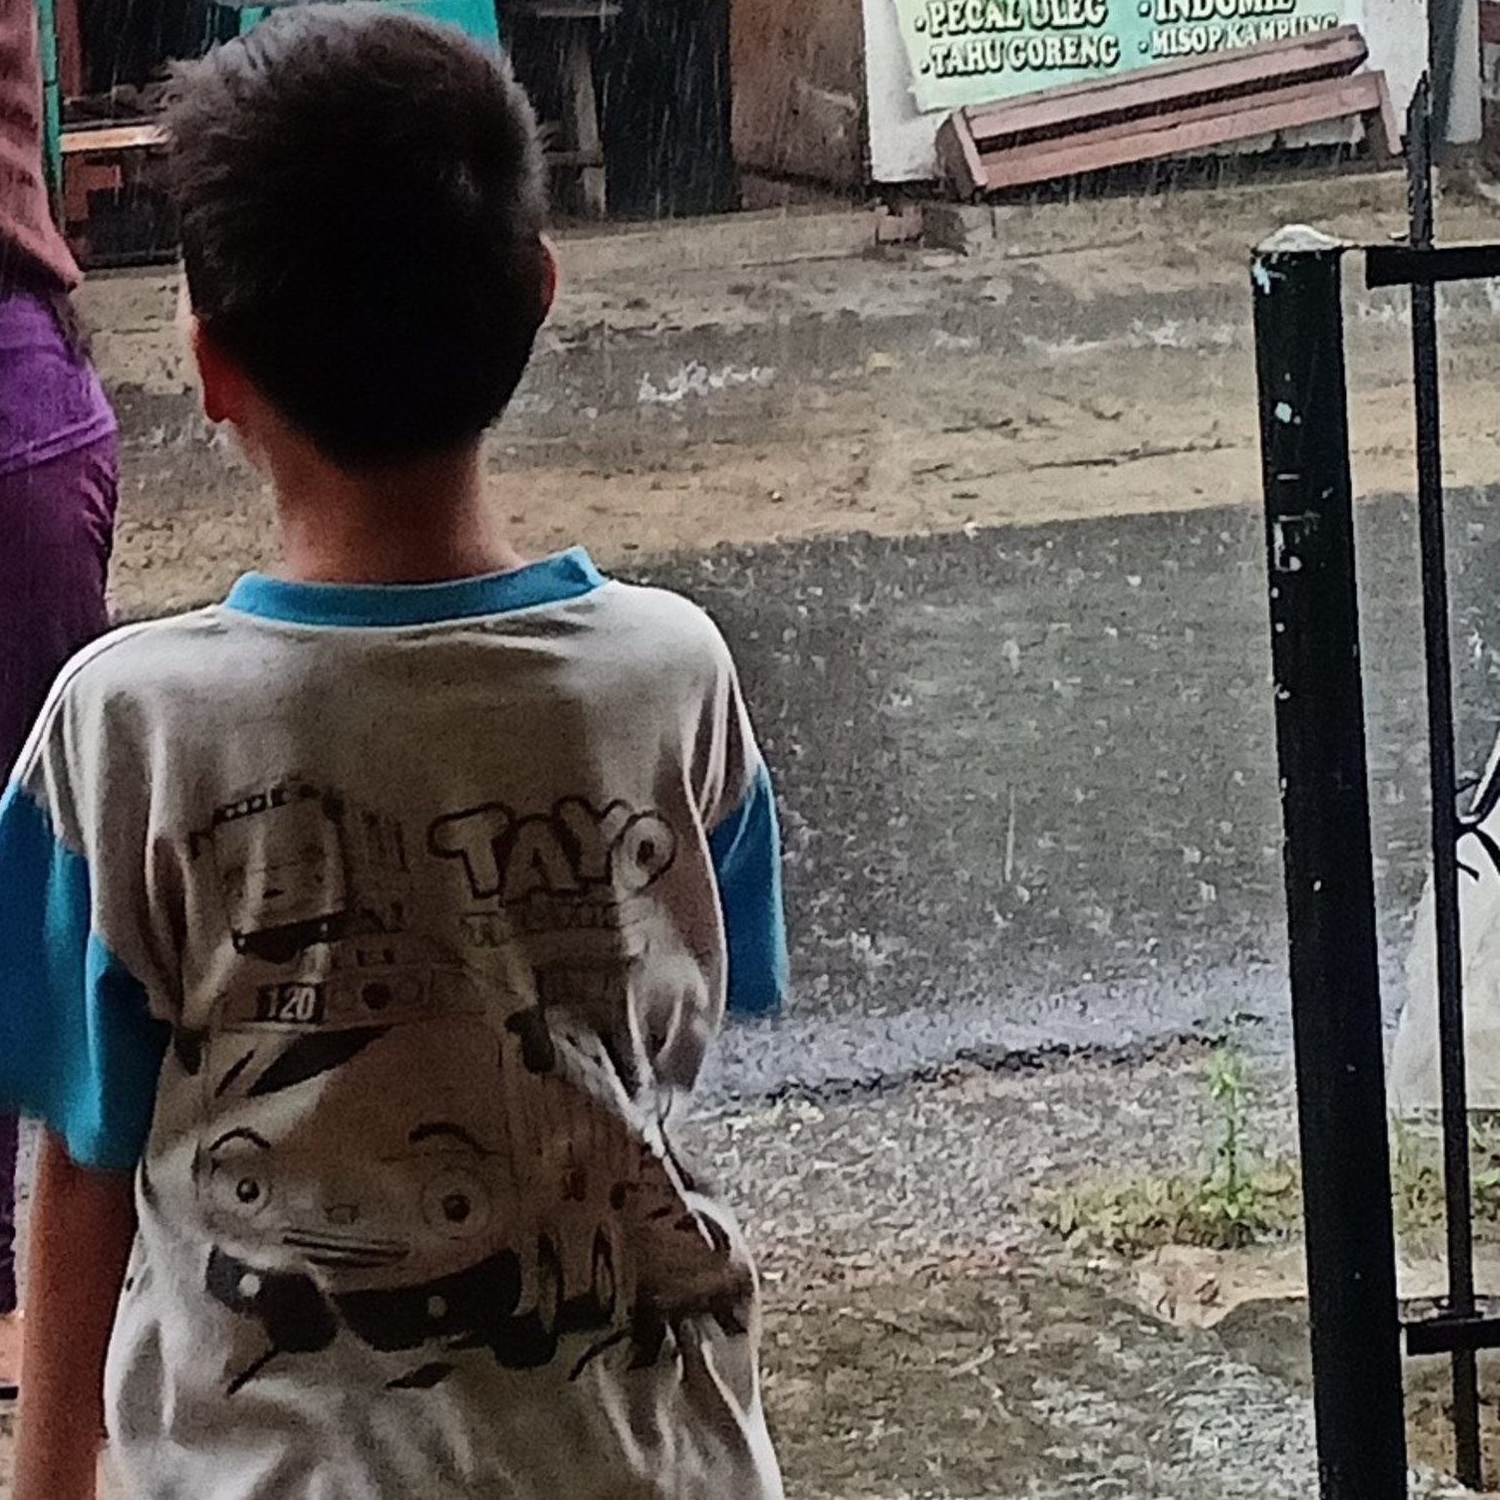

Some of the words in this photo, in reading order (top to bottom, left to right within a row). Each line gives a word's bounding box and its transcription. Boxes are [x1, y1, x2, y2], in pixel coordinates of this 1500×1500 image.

[929, 36, 1006, 78] TAHU
[1006, 32, 1121, 72] GORENG
[1150, 24, 1224, 59] MISOP
[427, 797, 680, 902] TAYO
[267, 982, 318, 1022] 120
